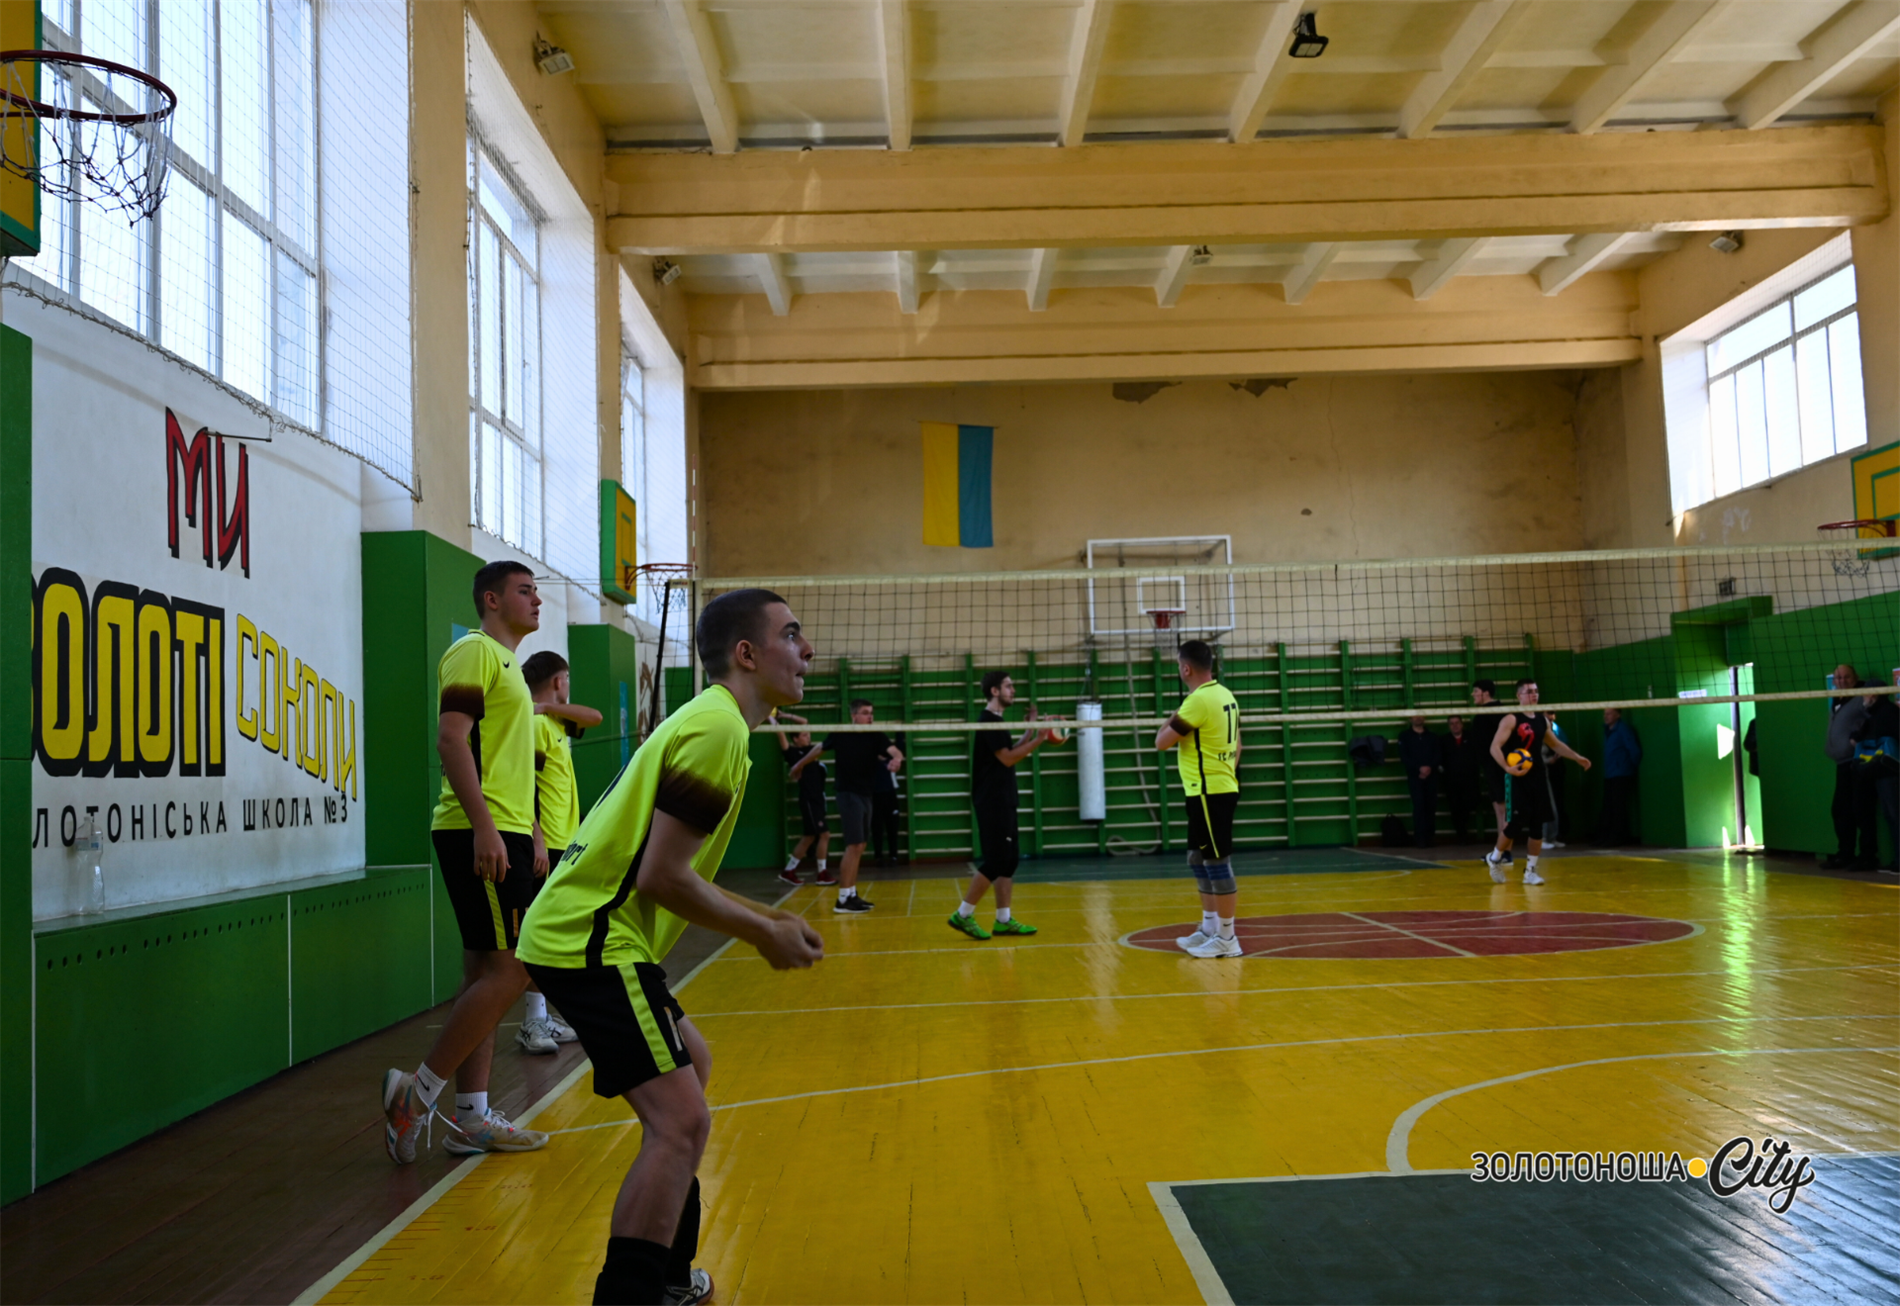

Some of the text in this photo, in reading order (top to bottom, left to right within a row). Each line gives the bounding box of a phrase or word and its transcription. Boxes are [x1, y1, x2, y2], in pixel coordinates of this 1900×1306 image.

[165, 406, 250, 579] МИ
[32, 567, 357, 802] ОЛОТІ СОКОЛИ
[243, 797, 313, 831] ШКОЛА
